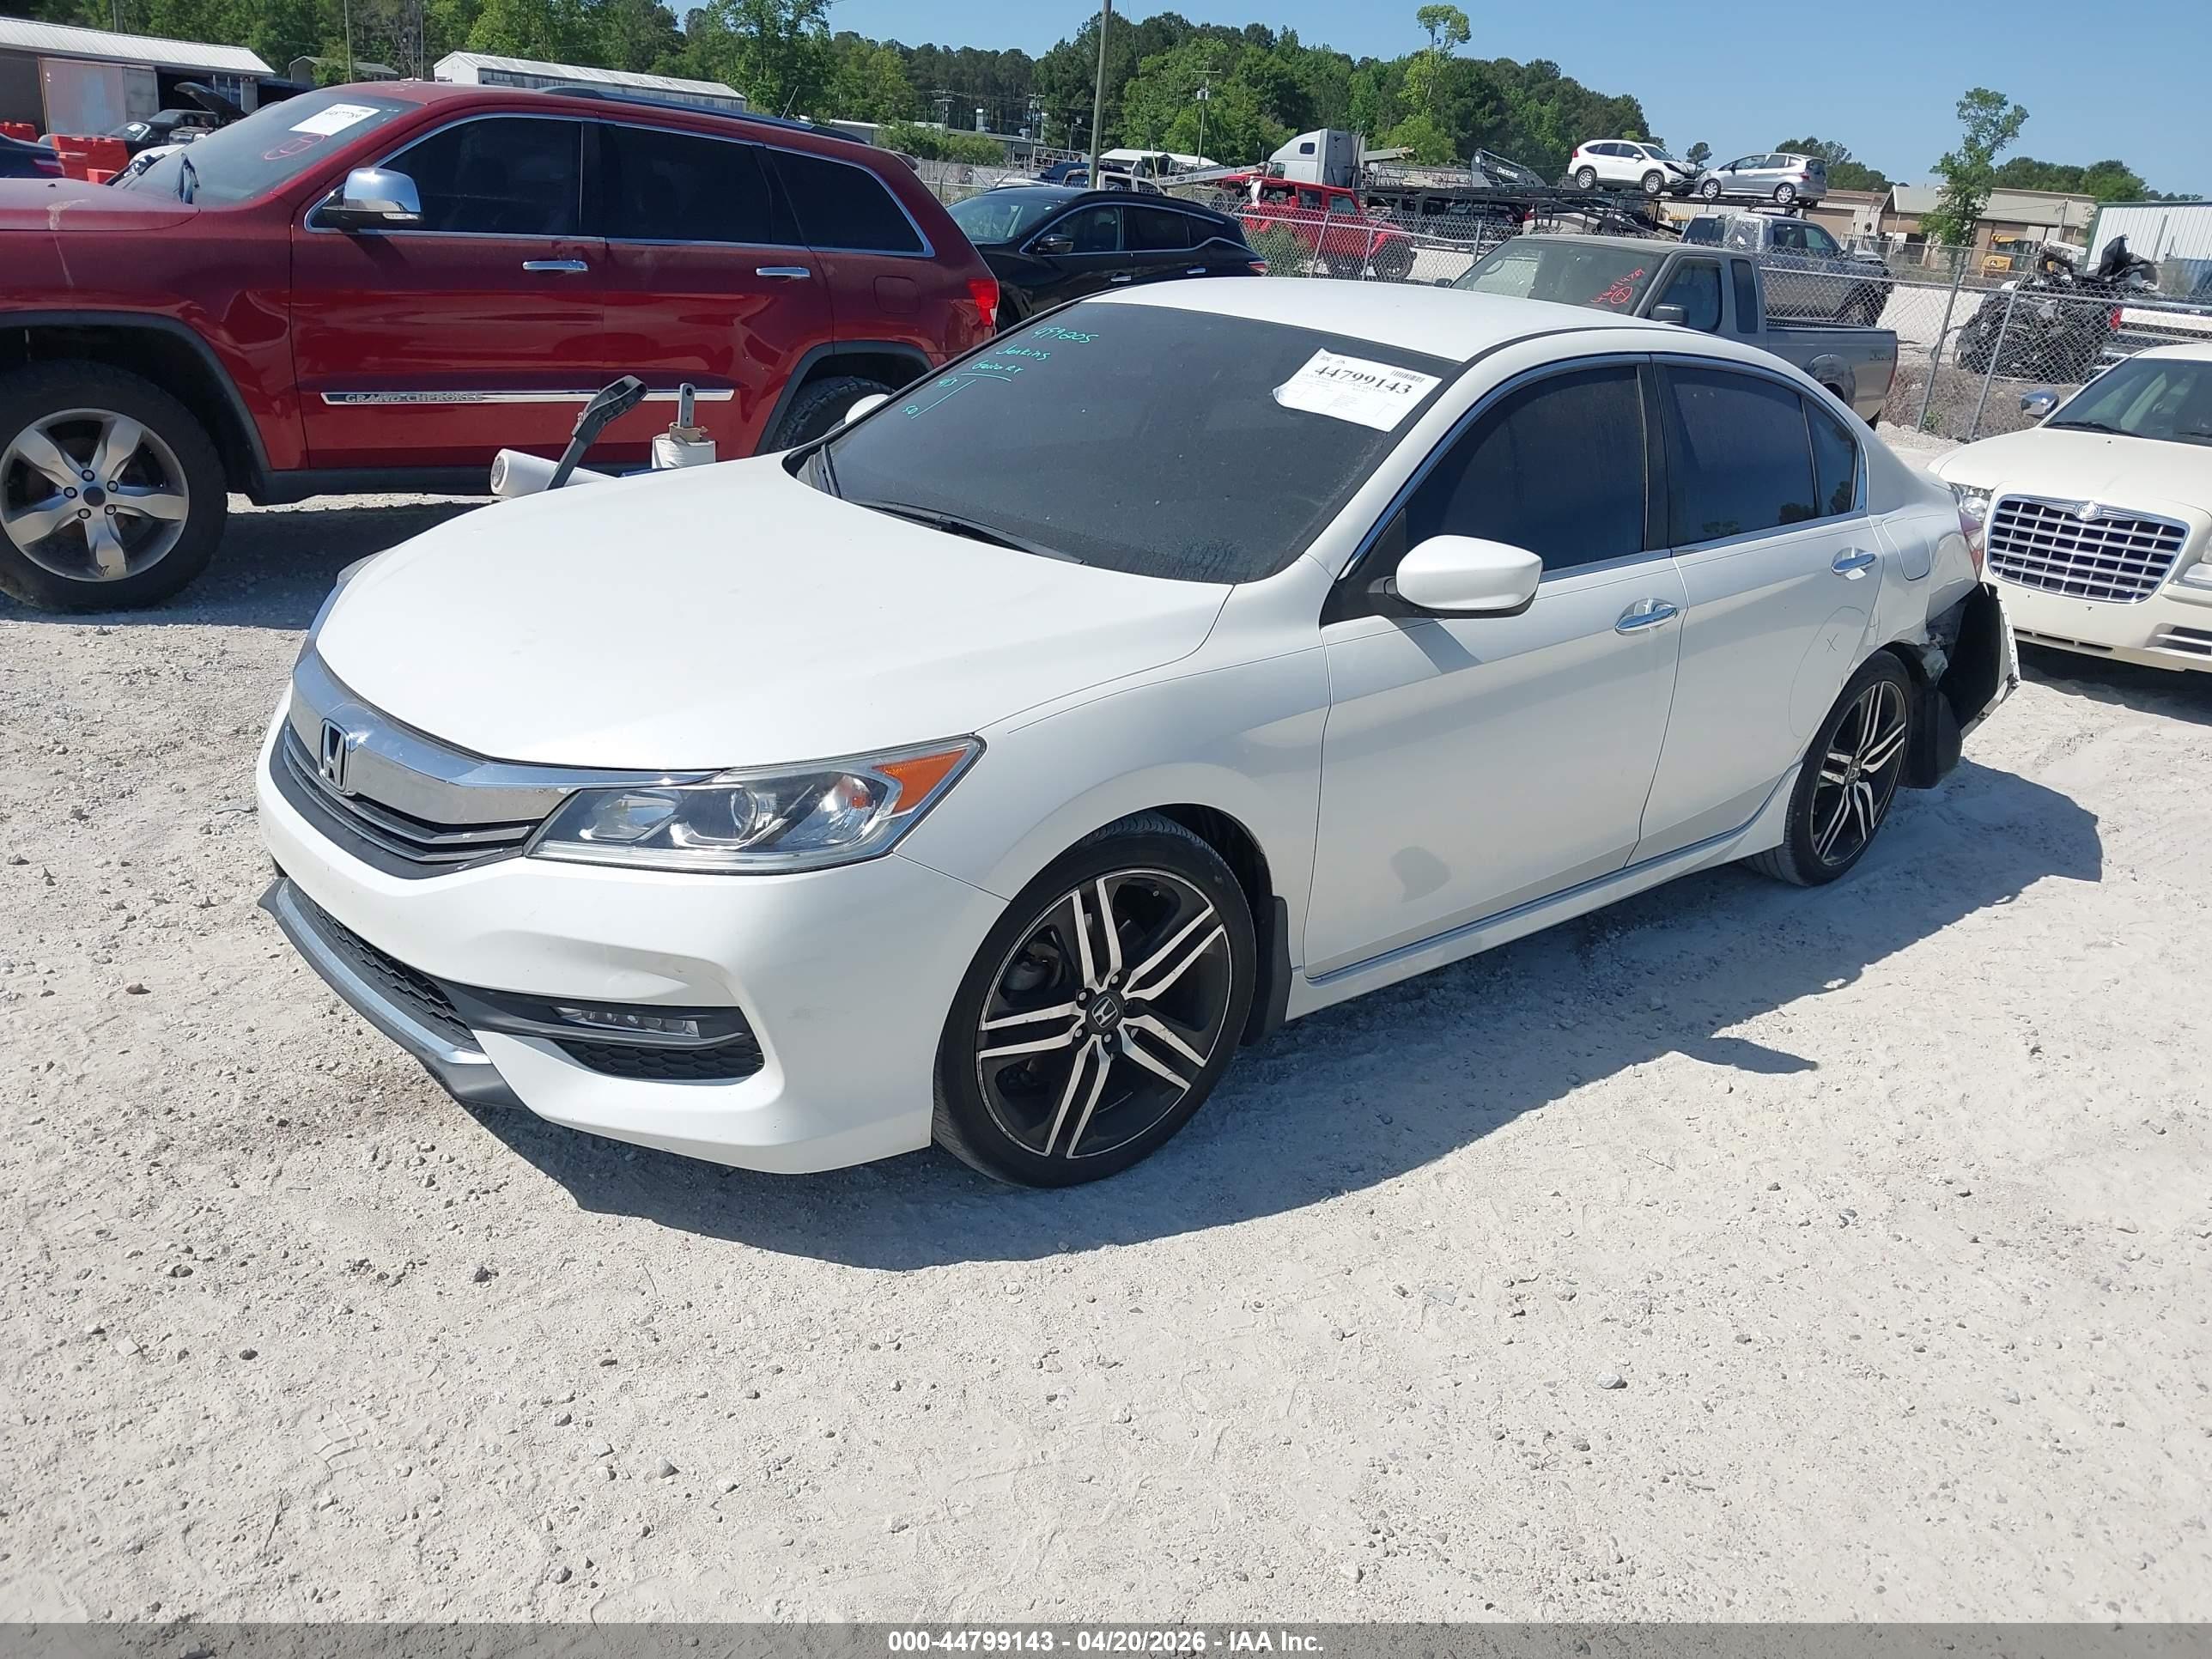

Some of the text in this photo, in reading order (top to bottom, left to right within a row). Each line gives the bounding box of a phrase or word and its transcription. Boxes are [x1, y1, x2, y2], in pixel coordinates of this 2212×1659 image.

[1496, 166, 1519, 179] DEERE
[1315, 366, 1413, 394] 44799143
[345, 393, 401, 403] GRAND
